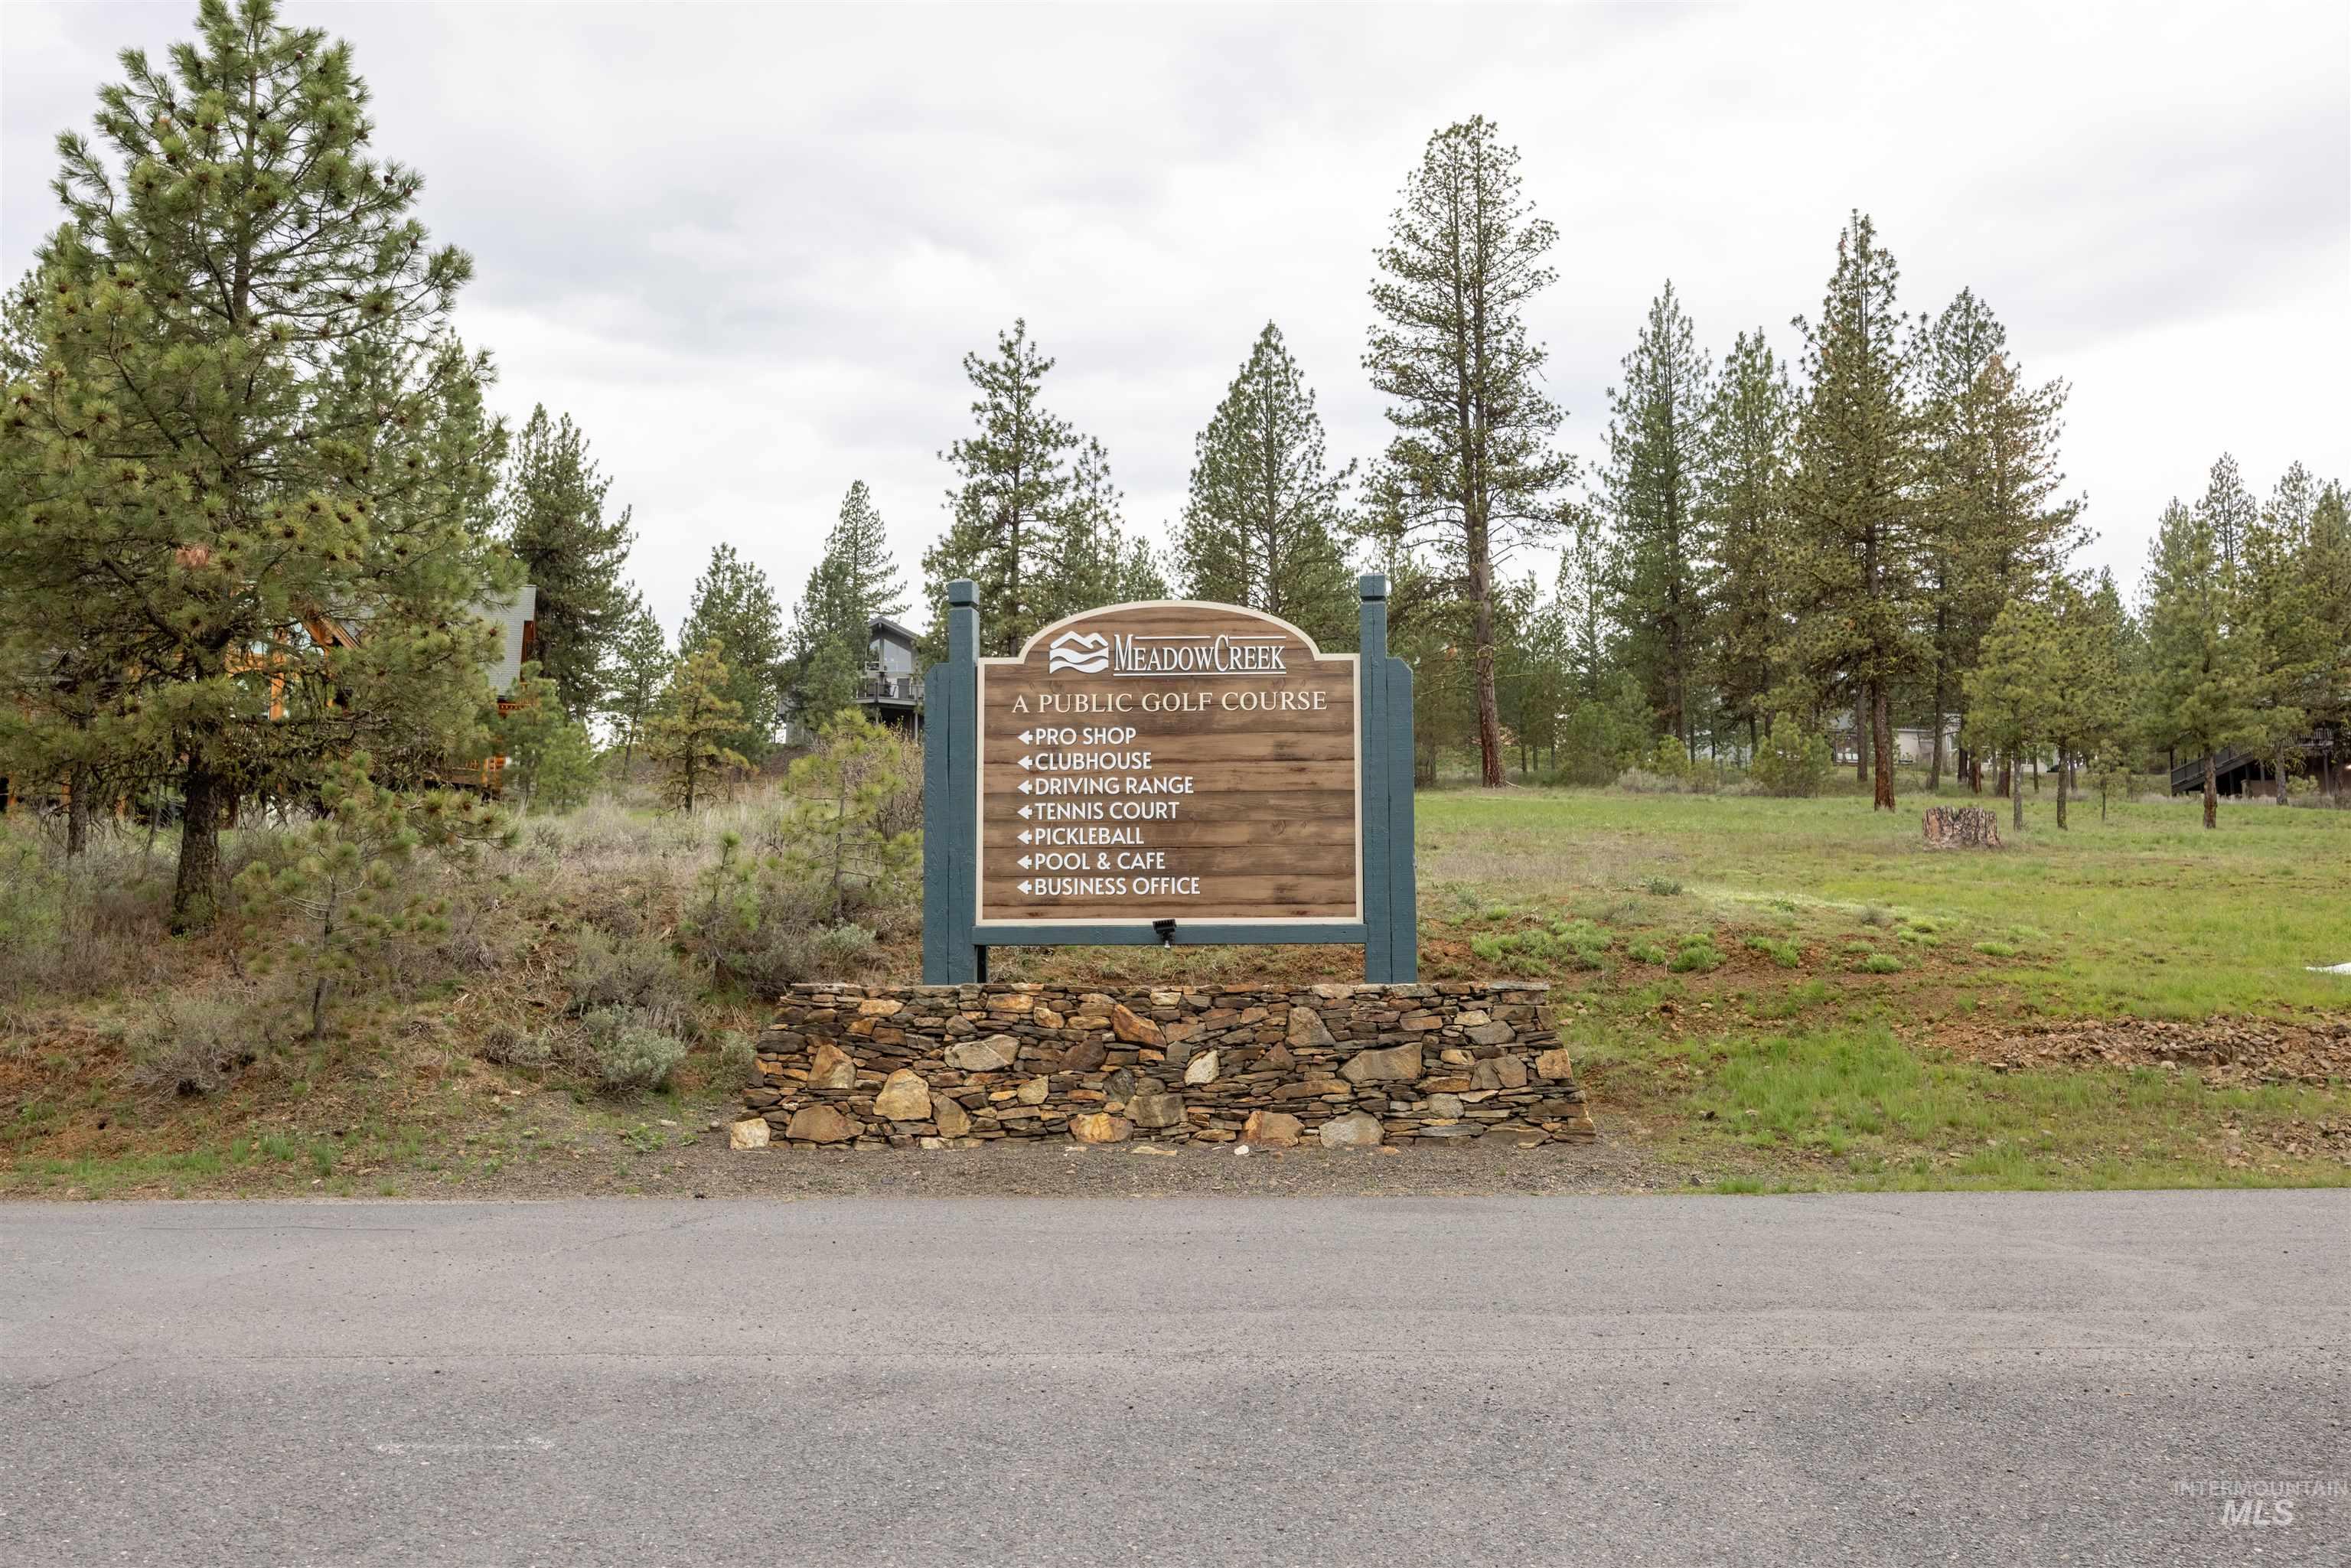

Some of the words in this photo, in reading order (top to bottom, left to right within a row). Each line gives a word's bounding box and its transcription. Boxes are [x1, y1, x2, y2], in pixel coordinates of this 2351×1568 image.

[1012, 696, 1030, 713] A
[1039, 694, 1133, 713] PUBLIC
[1142, 693, 1213, 712] GOLF
[1221, 691, 1328, 711] COURSE
[1035, 729, 1077, 745] PRO
[1084, 728, 1136, 745] SHOP
[1035, 752, 1152, 770] CLUBHOUSE
[1035, 777, 1120, 795] DRIVING
[1127, 777, 1194, 794] RANGE
[1035, 802, 1104, 820] TENNIS
[1109, 802, 1179, 820] COURT
[1035, 827, 1144, 846] PICKLEBALL
[1035, 853, 1090, 870] POOL
[1097, 853, 1111, 870] &
[1117, 852, 1166, 870] CAFE
[1035, 878, 1127, 895] BUSINESS
[1133, 877, 1201, 895] OFFICE
